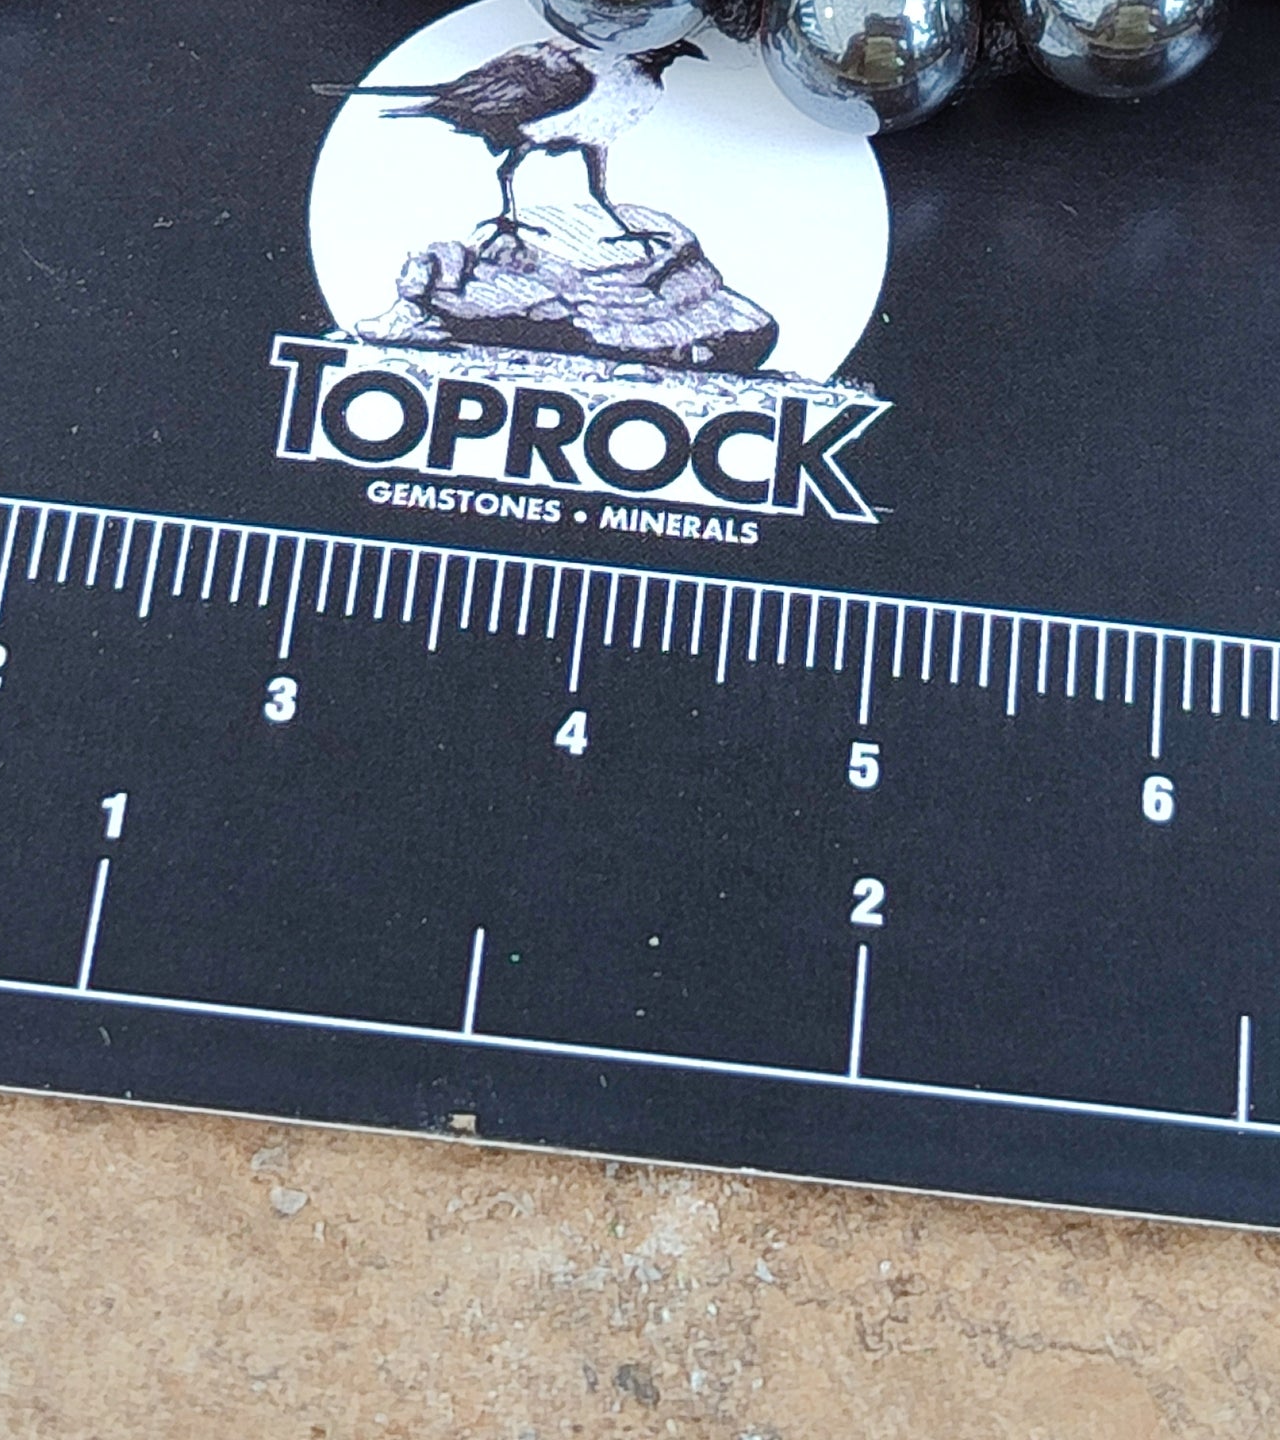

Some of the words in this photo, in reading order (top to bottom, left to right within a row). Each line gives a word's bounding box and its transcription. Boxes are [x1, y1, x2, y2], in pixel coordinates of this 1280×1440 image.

[270, 335, 893, 524] TOPROCK
[366, 480, 562, 524] GEMSTONES
[599, 505, 760, 546] MINERALS
[263, 675, 299, 723] 3
[553, 709, 589, 757] 4
[847, 740, 881, 790] 5
[1140, 774, 1176, 823] 6
[101, 791, 129, 840] 1
[849, 876, 886, 927] 2
